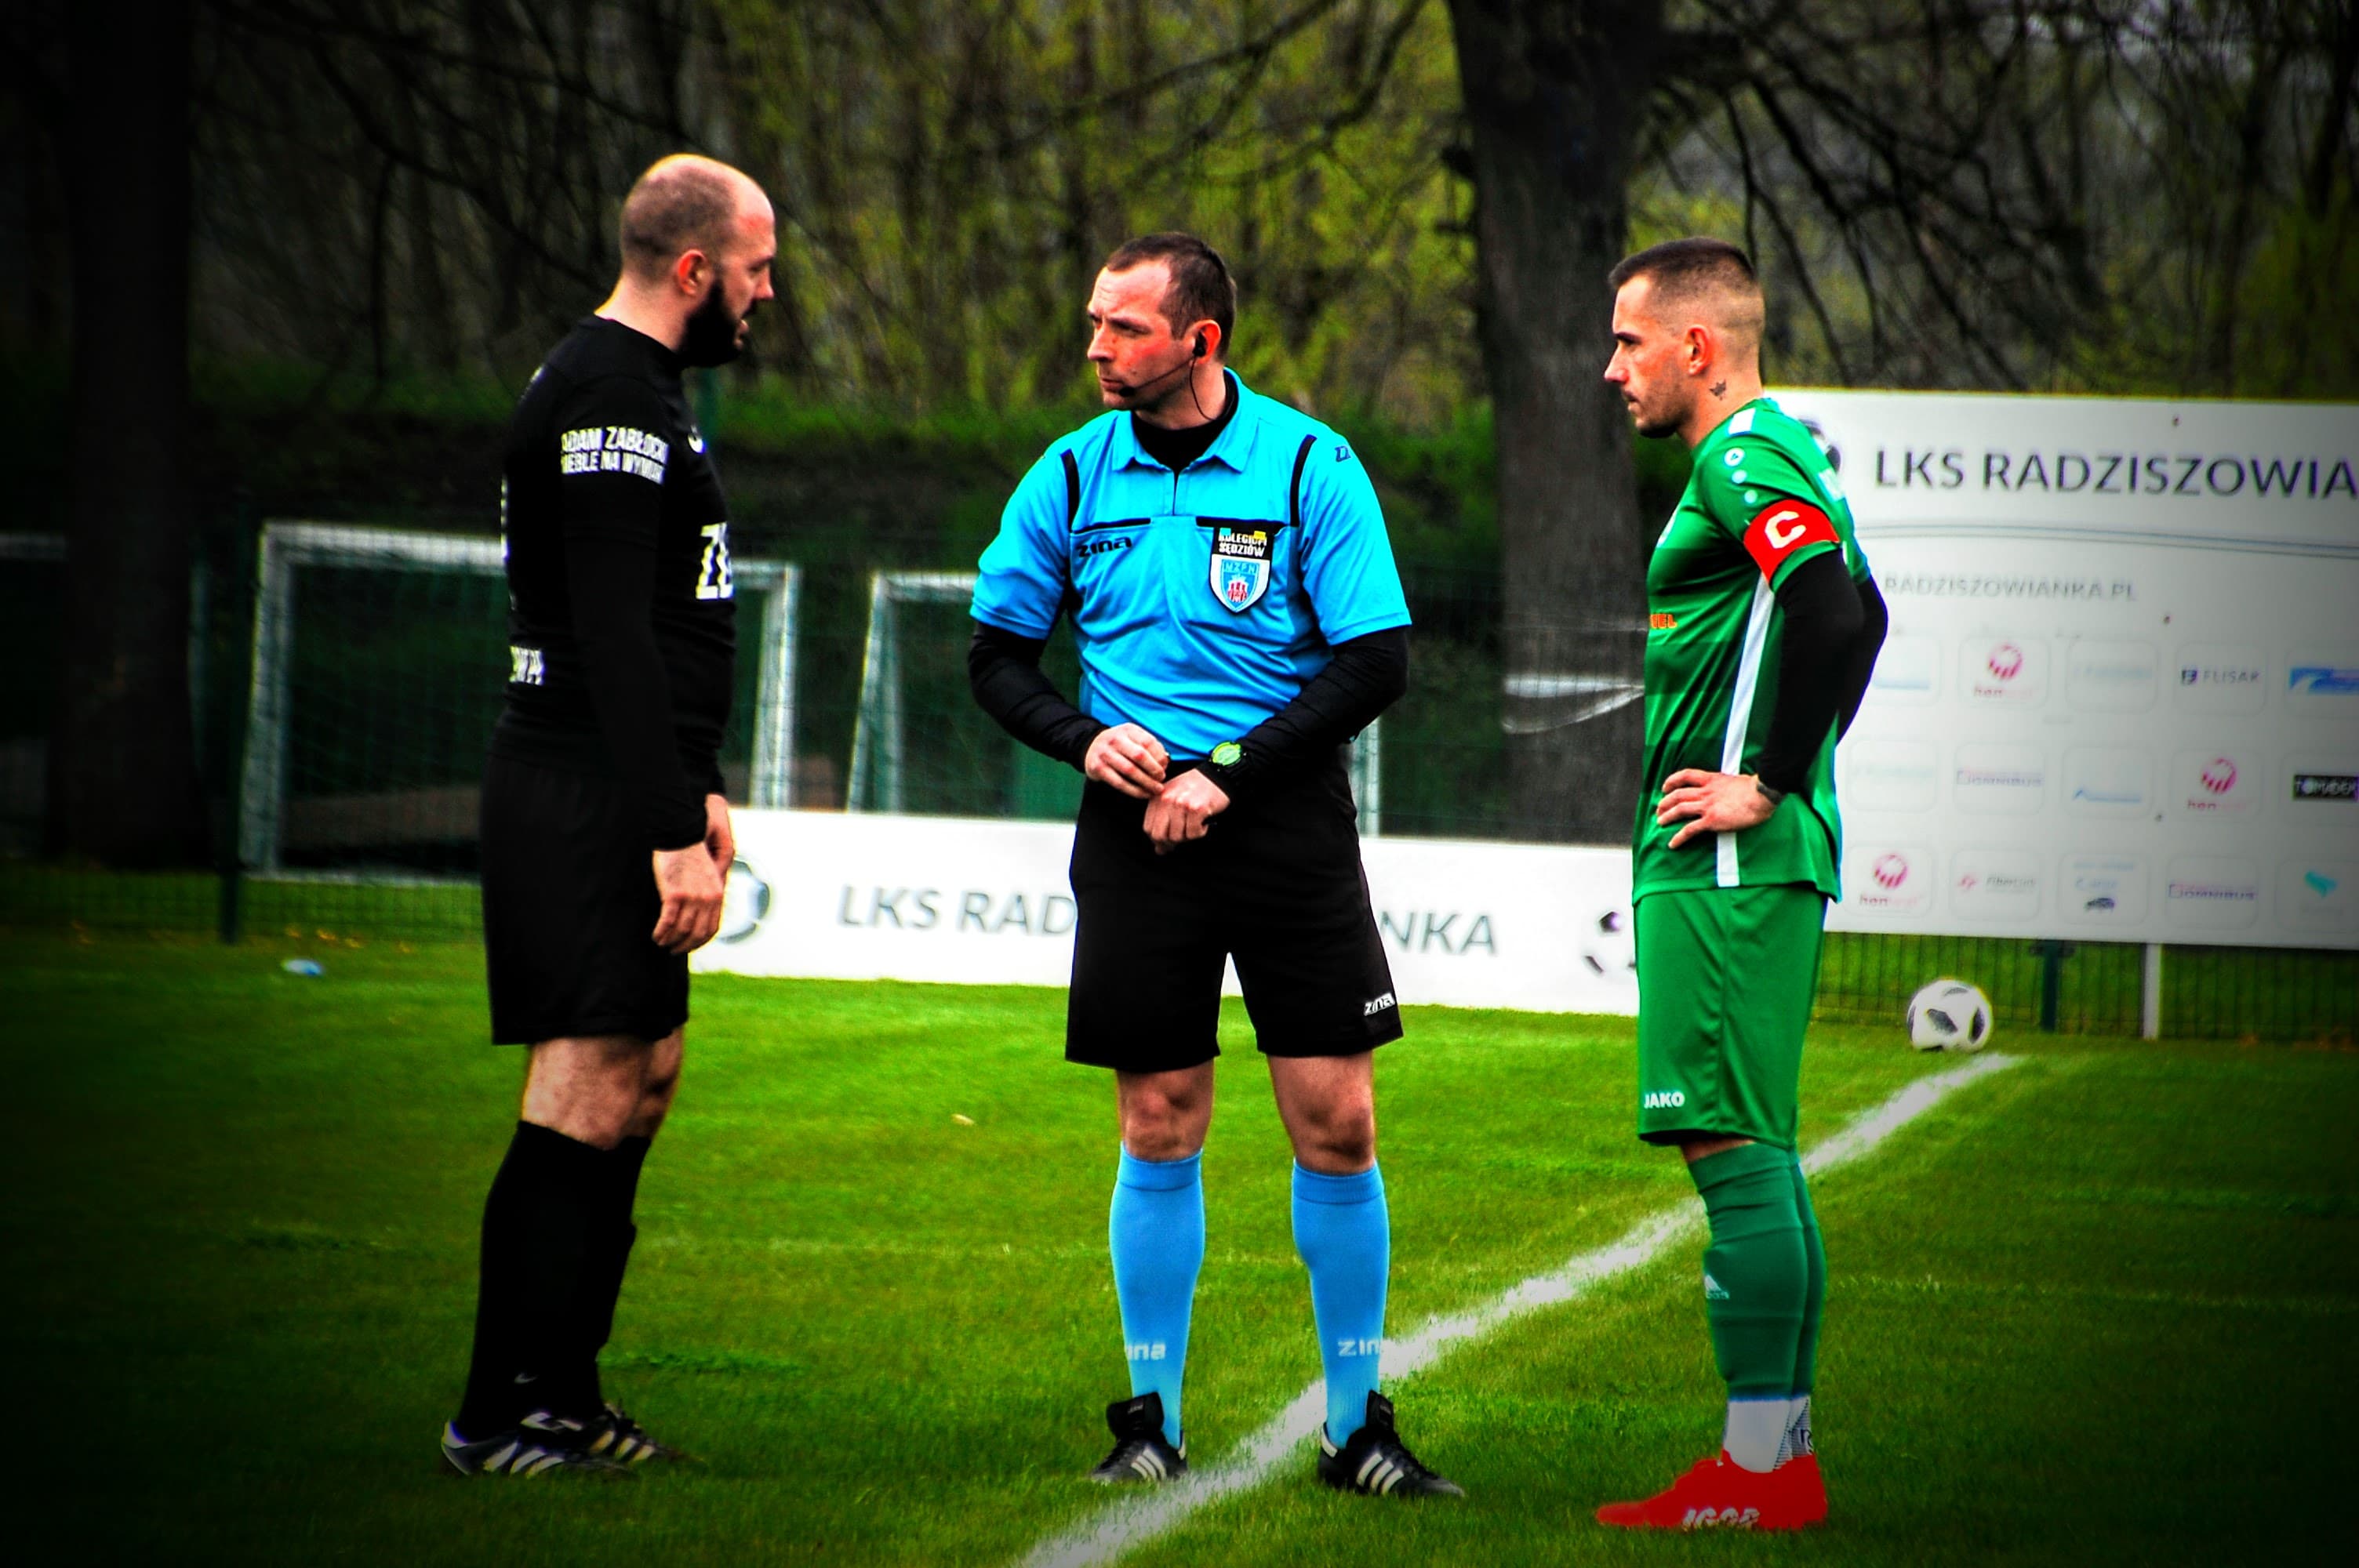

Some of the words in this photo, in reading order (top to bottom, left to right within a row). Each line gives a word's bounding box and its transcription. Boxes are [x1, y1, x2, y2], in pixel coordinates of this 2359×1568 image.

[1875, 450, 1964, 488] LKS
[1983, 452, 2359, 499] RADZISZOWIA
[1764, 510, 1807, 549] C
[1883, 577, 2138, 602] RADZISZOWIANKAPL
[838, 884, 942, 929] LKS
[1644, 1091, 1685, 1109] JAKO
[1337, 1338, 1380, 1357] zin
